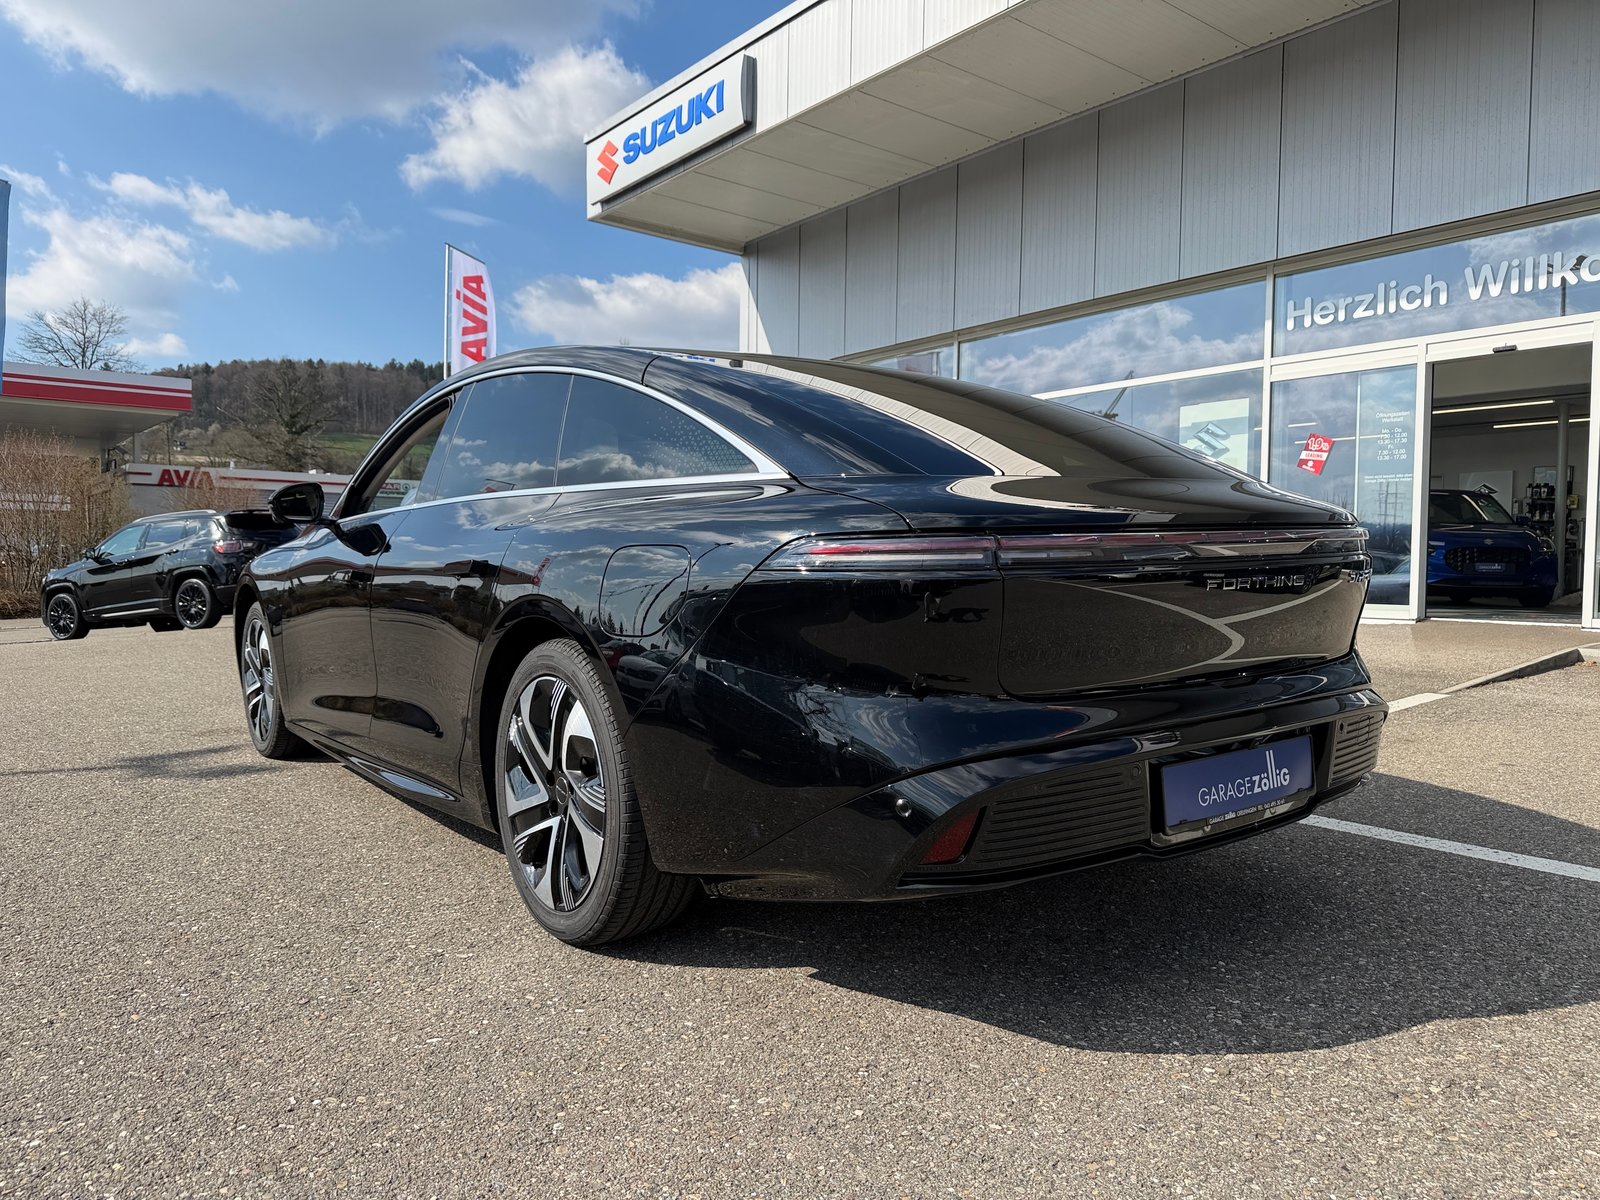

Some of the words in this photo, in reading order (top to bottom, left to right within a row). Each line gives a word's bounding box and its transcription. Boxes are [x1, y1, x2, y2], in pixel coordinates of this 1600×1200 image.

[623, 80, 724, 164] SUZUKI
[456, 275, 488, 363] AVIA
[1286, 273, 1448, 331] Herzlich
[157, 465, 215, 490] AVIA
[1206, 574, 1305, 591] FORTHING
